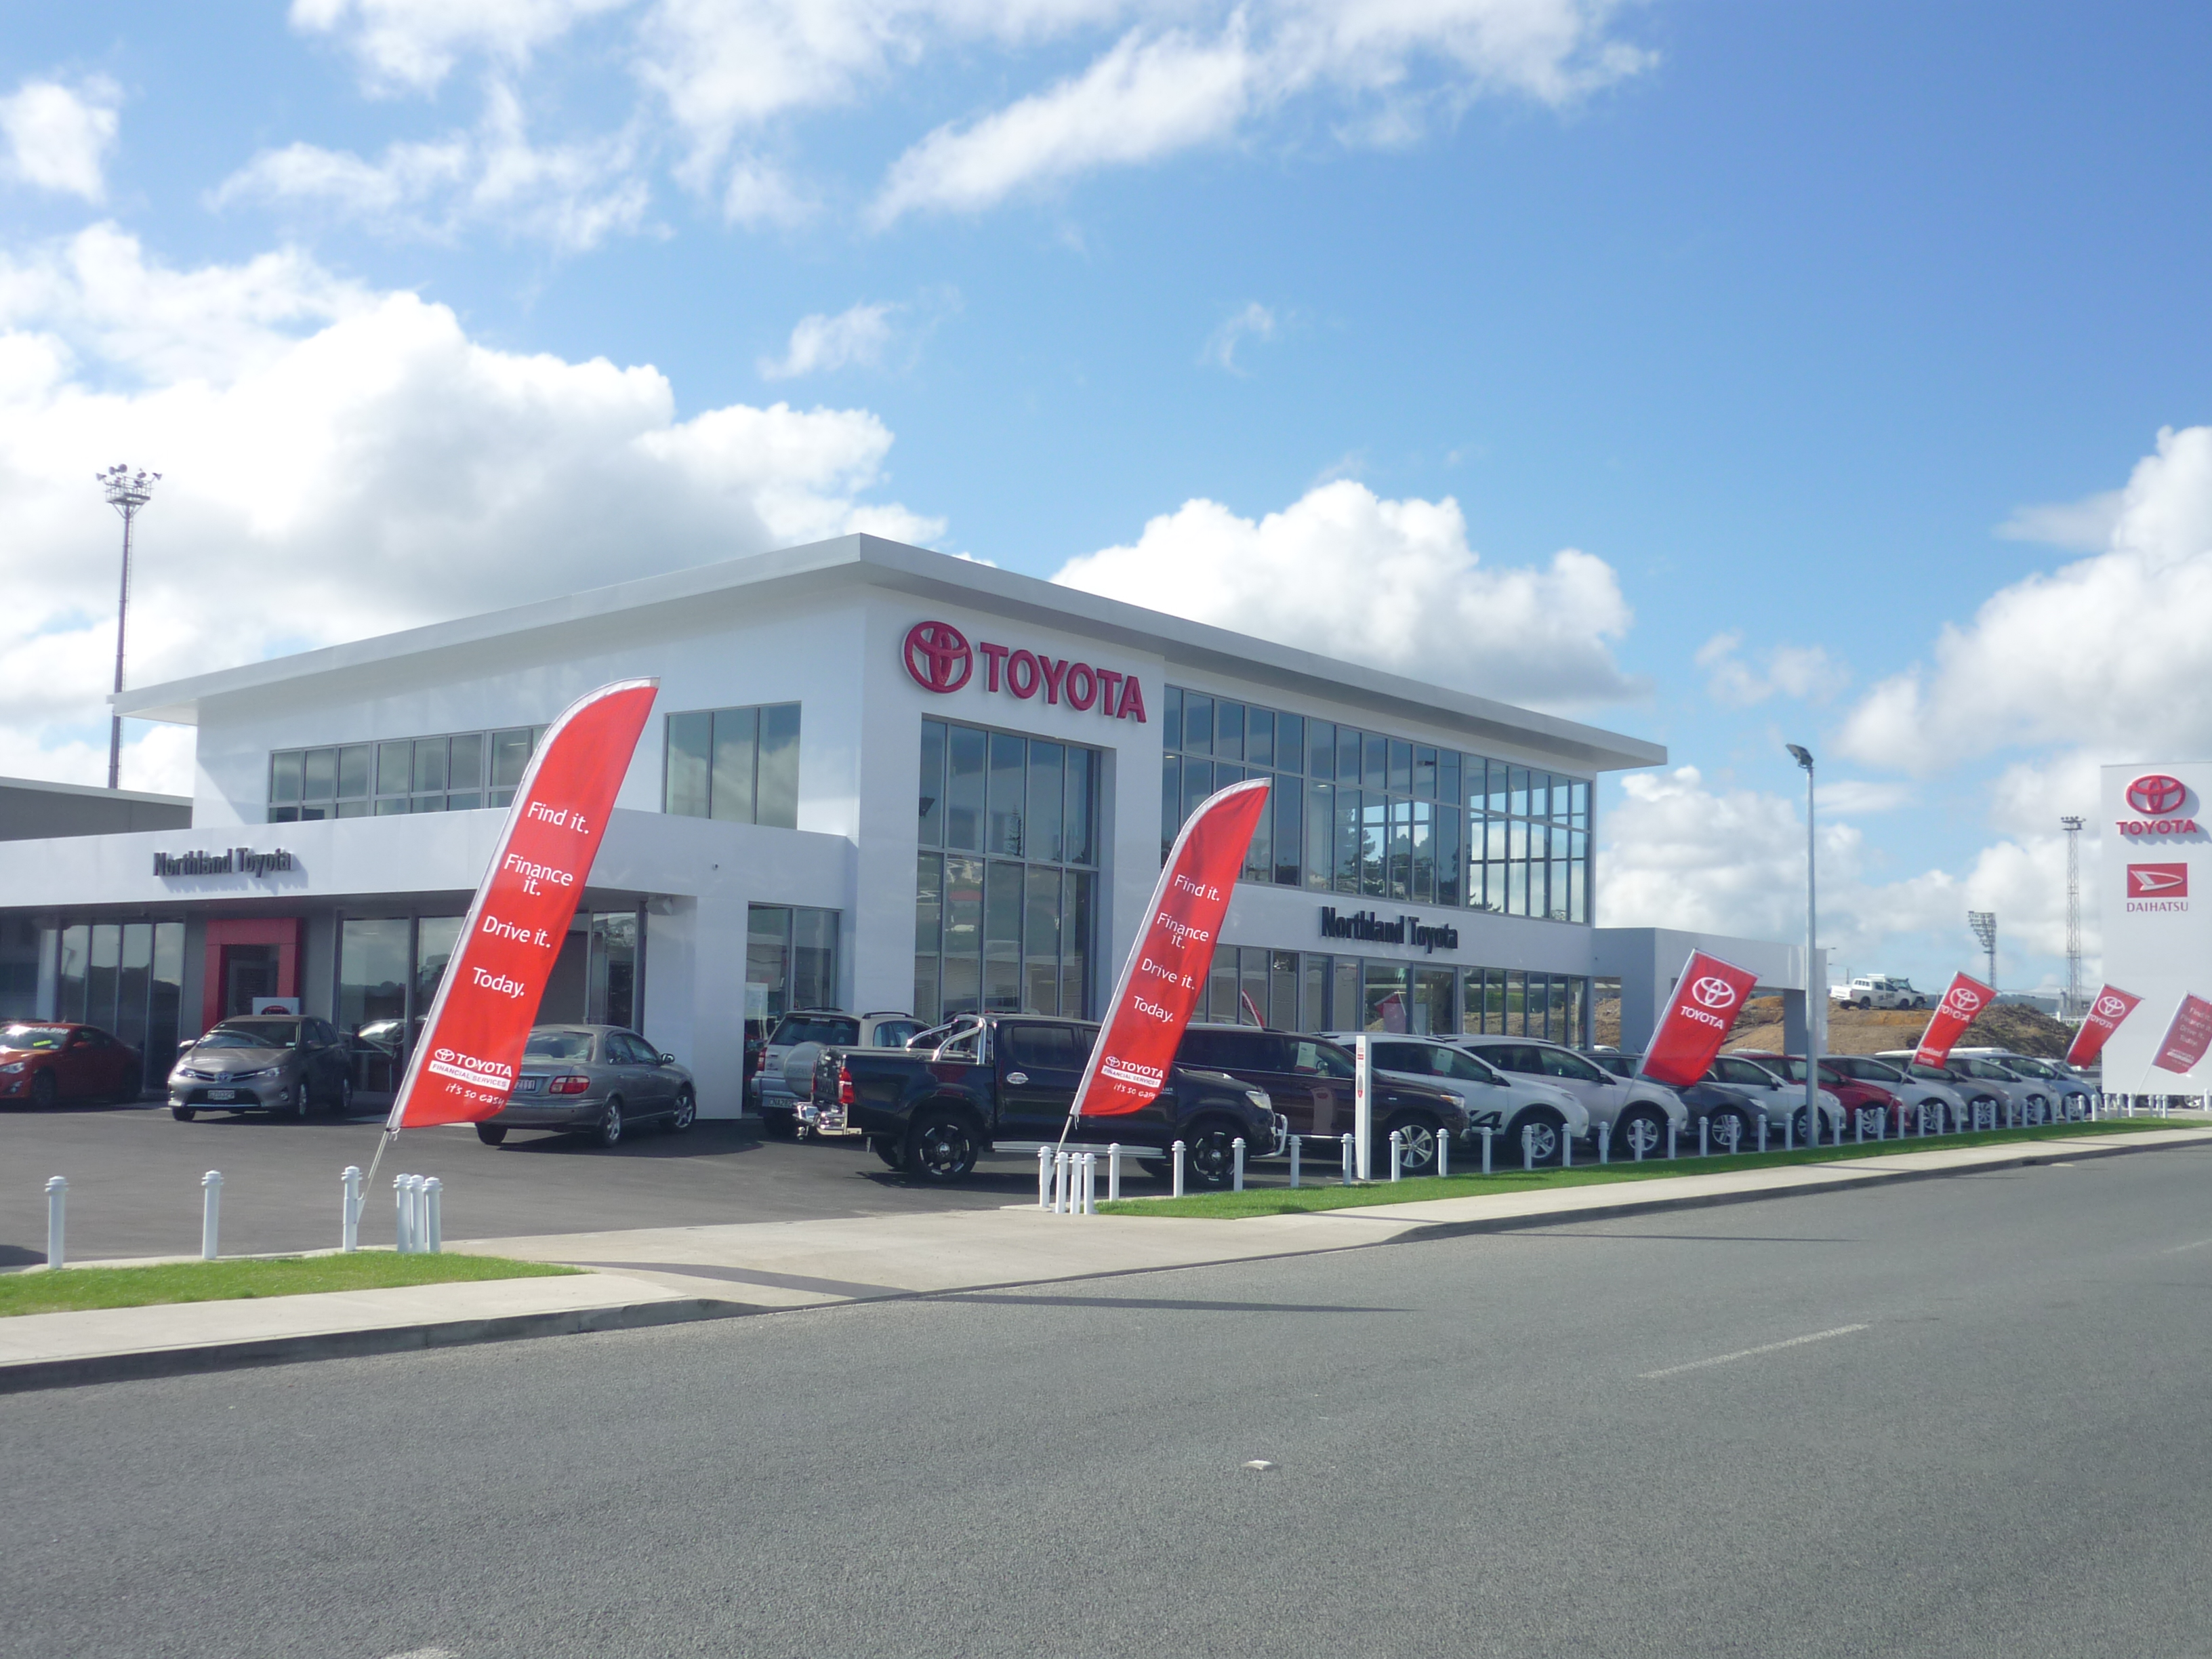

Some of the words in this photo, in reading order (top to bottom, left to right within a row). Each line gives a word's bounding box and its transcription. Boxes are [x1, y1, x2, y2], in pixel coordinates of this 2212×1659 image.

[980, 642, 1147, 723] TOYOTA
[527, 801, 568, 825] Find
[570, 813, 589, 834] it.
[2116, 819, 2198, 836] TOYOTA
[153, 848, 232, 876] Northland
[236, 847, 291, 878] Toyota
[504, 853, 573, 886] Finance
[523, 876, 541, 896] it.
[1174, 874, 1206, 897] Find
[1207, 886, 1220, 901] it.
[2127, 901, 2189, 913] DAIHATSU
[483, 915, 531, 943] Drive
[533, 928, 550, 948] it.
[1157, 912, 1209, 941] Finance
[1319, 906, 1404, 944] Northland
[1408, 916, 1458, 954] Toyota
[1171, 933, 1185, 949] it.
[473, 966, 525, 998] Today.
[1141, 958, 1177, 983] Drive
[1181, 974, 1195, 990] it.
[1134, 996, 1173, 1023] Today.
[1681, 1006, 1723, 1029] TOYOTA
[432, 1063, 470, 1080] FINANCIAL
[472, 1075, 508, 1088] SERVICES
[456, 1053, 512, 1078] TOYOTA
[1103, 1067, 1132, 1080] FINANCIAL
[1132, 1076, 1159, 1086] SERVICES
[1122, 1061, 1164, 1079] TOYOTA
[445, 1083, 462, 1094] it's
[464, 1090, 476, 1099] so
[479, 1094, 504, 1109] easy
